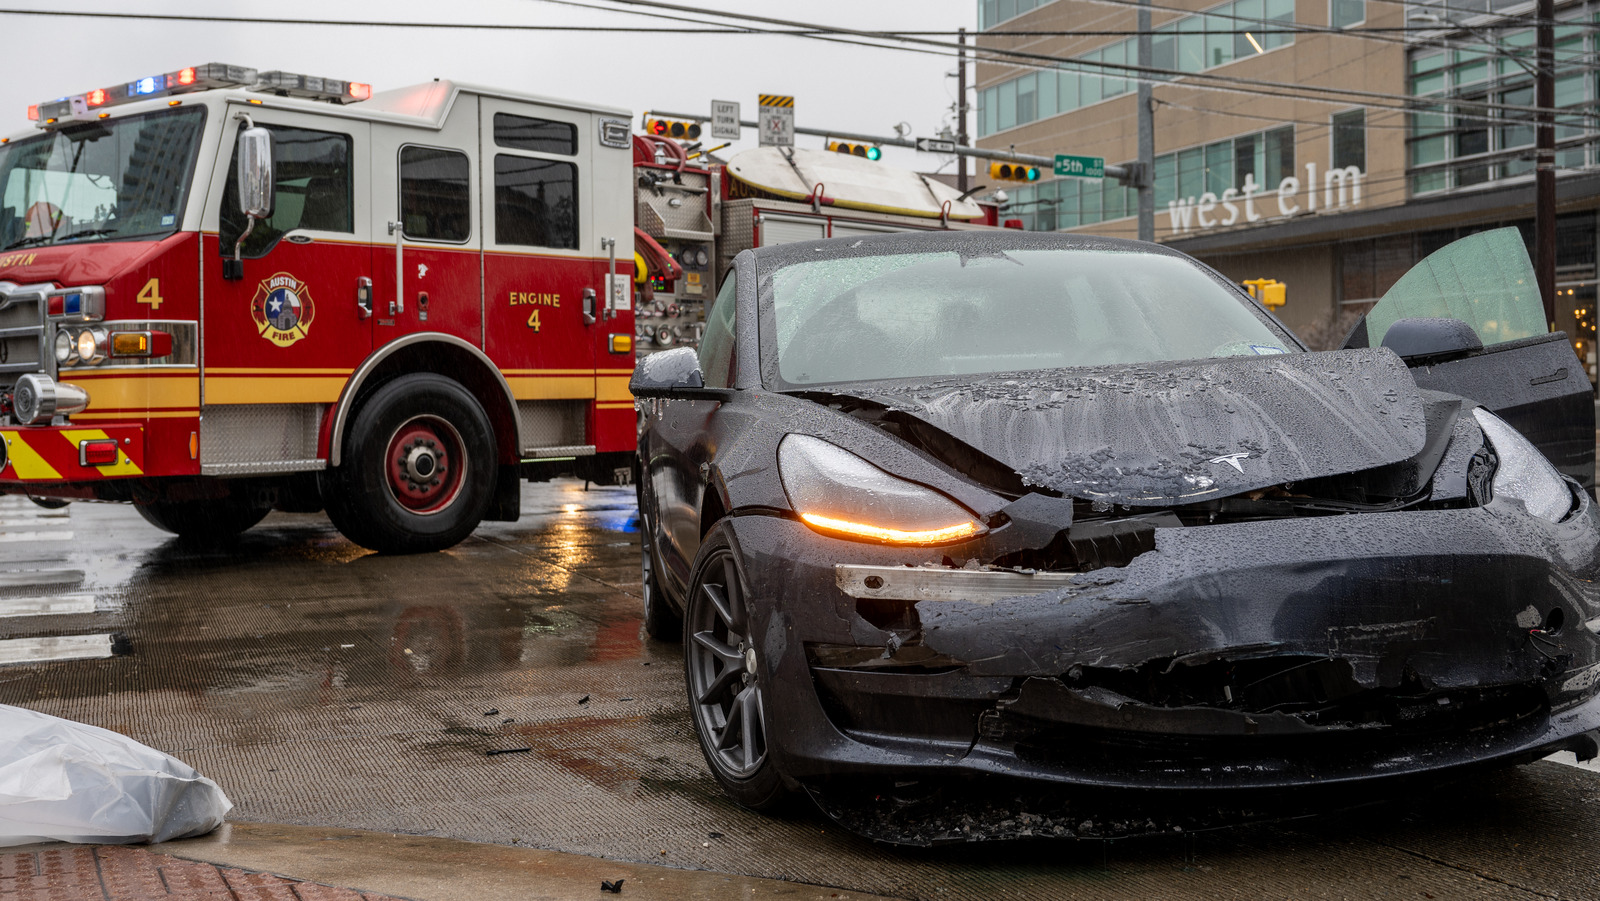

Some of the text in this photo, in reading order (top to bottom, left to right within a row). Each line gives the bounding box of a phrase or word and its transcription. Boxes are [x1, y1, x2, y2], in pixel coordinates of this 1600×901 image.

[717, 105, 733, 113] LEFT
[716, 116, 735, 124] TURN
[714, 127, 738, 135] SIGNAL
[1062, 159, 1083, 173] 5th
[1168, 162, 1361, 234] west elm
[270, 276, 297, 290] AUSTIN
[136, 278, 164, 310] 4
[509, 291, 561, 308] ENGINE
[526, 309, 541, 334] 4
[272, 331, 296, 341] FIRE
